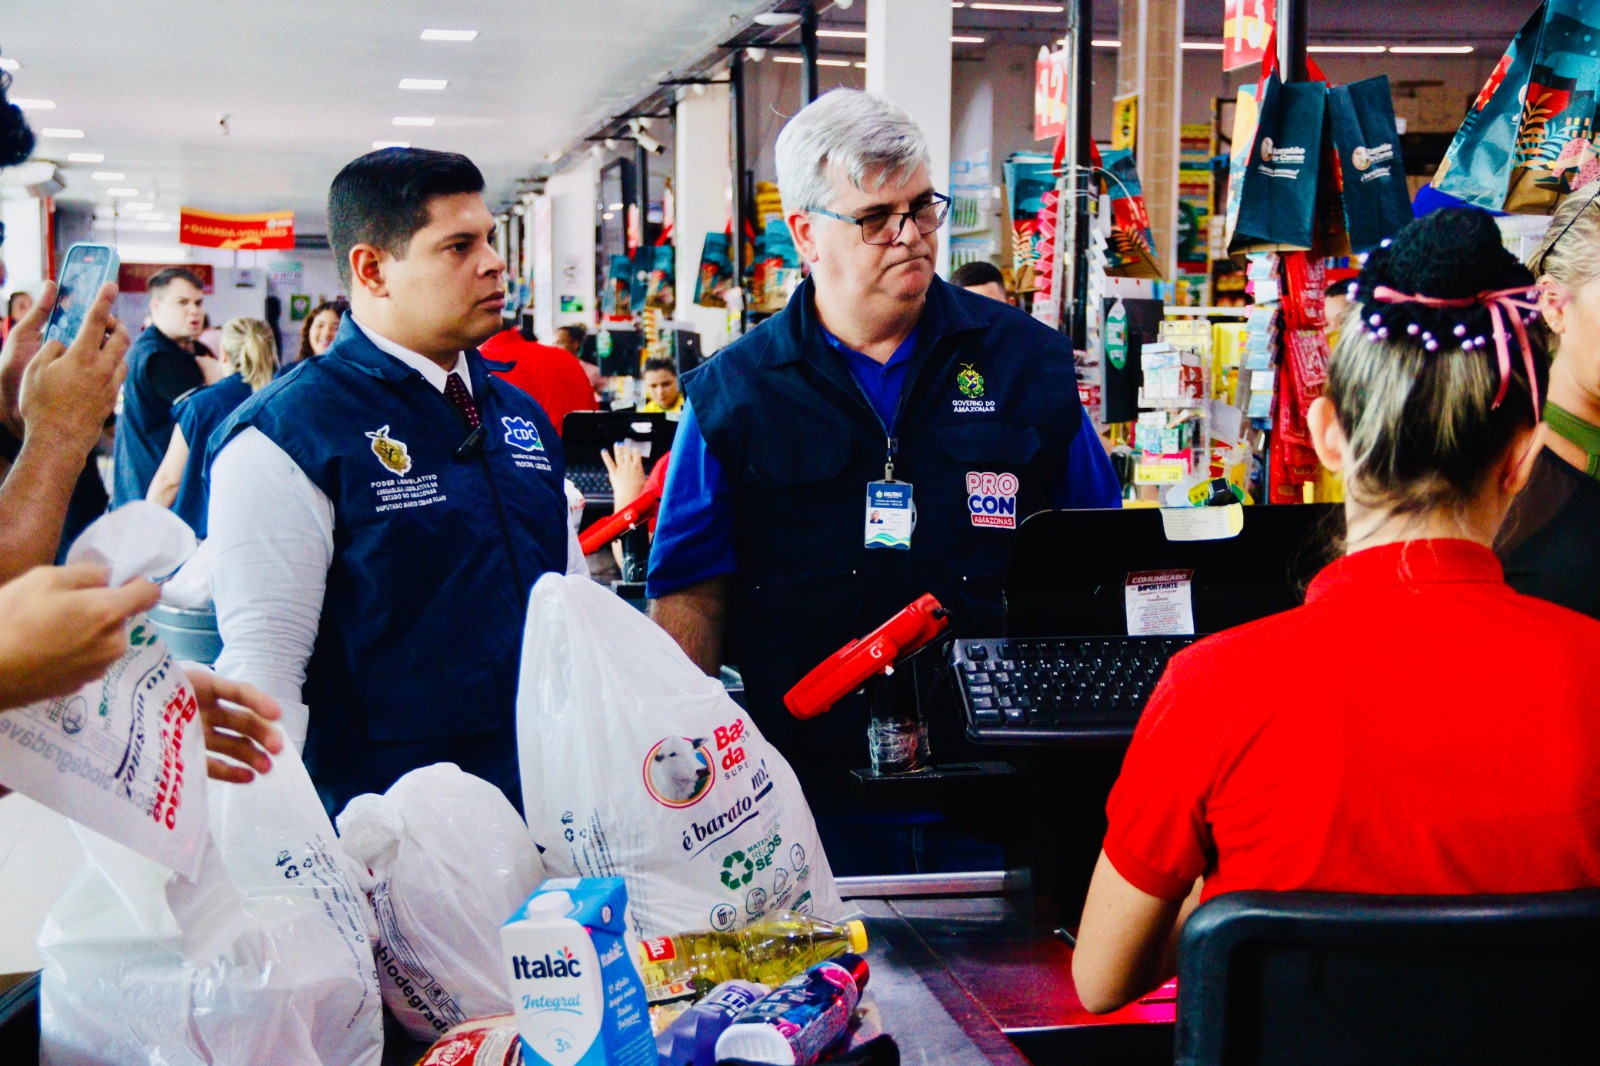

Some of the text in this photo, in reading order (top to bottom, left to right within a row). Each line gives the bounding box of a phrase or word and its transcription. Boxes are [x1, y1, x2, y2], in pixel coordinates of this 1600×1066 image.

[1039, 62, 1065, 127] 12
[513, 428, 537, 441] CDC
[371, 474, 437, 488] PODER LEGISLATIVO
[967, 473, 1018, 496] PRO
[969, 495, 1015, 515] CON
[974, 516, 1013, 526] AMAZONAS
[1131, 573, 1187, 584] COMUNICADO
[1137, 582, 1178, 592] IMPORTANTE
[722, 746, 746, 771] da
[682, 830, 693, 851] é
[691, 796, 752, 842] barato
[512, 953, 582, 980] Italac
[522, 993, 582, 1012] Integral
